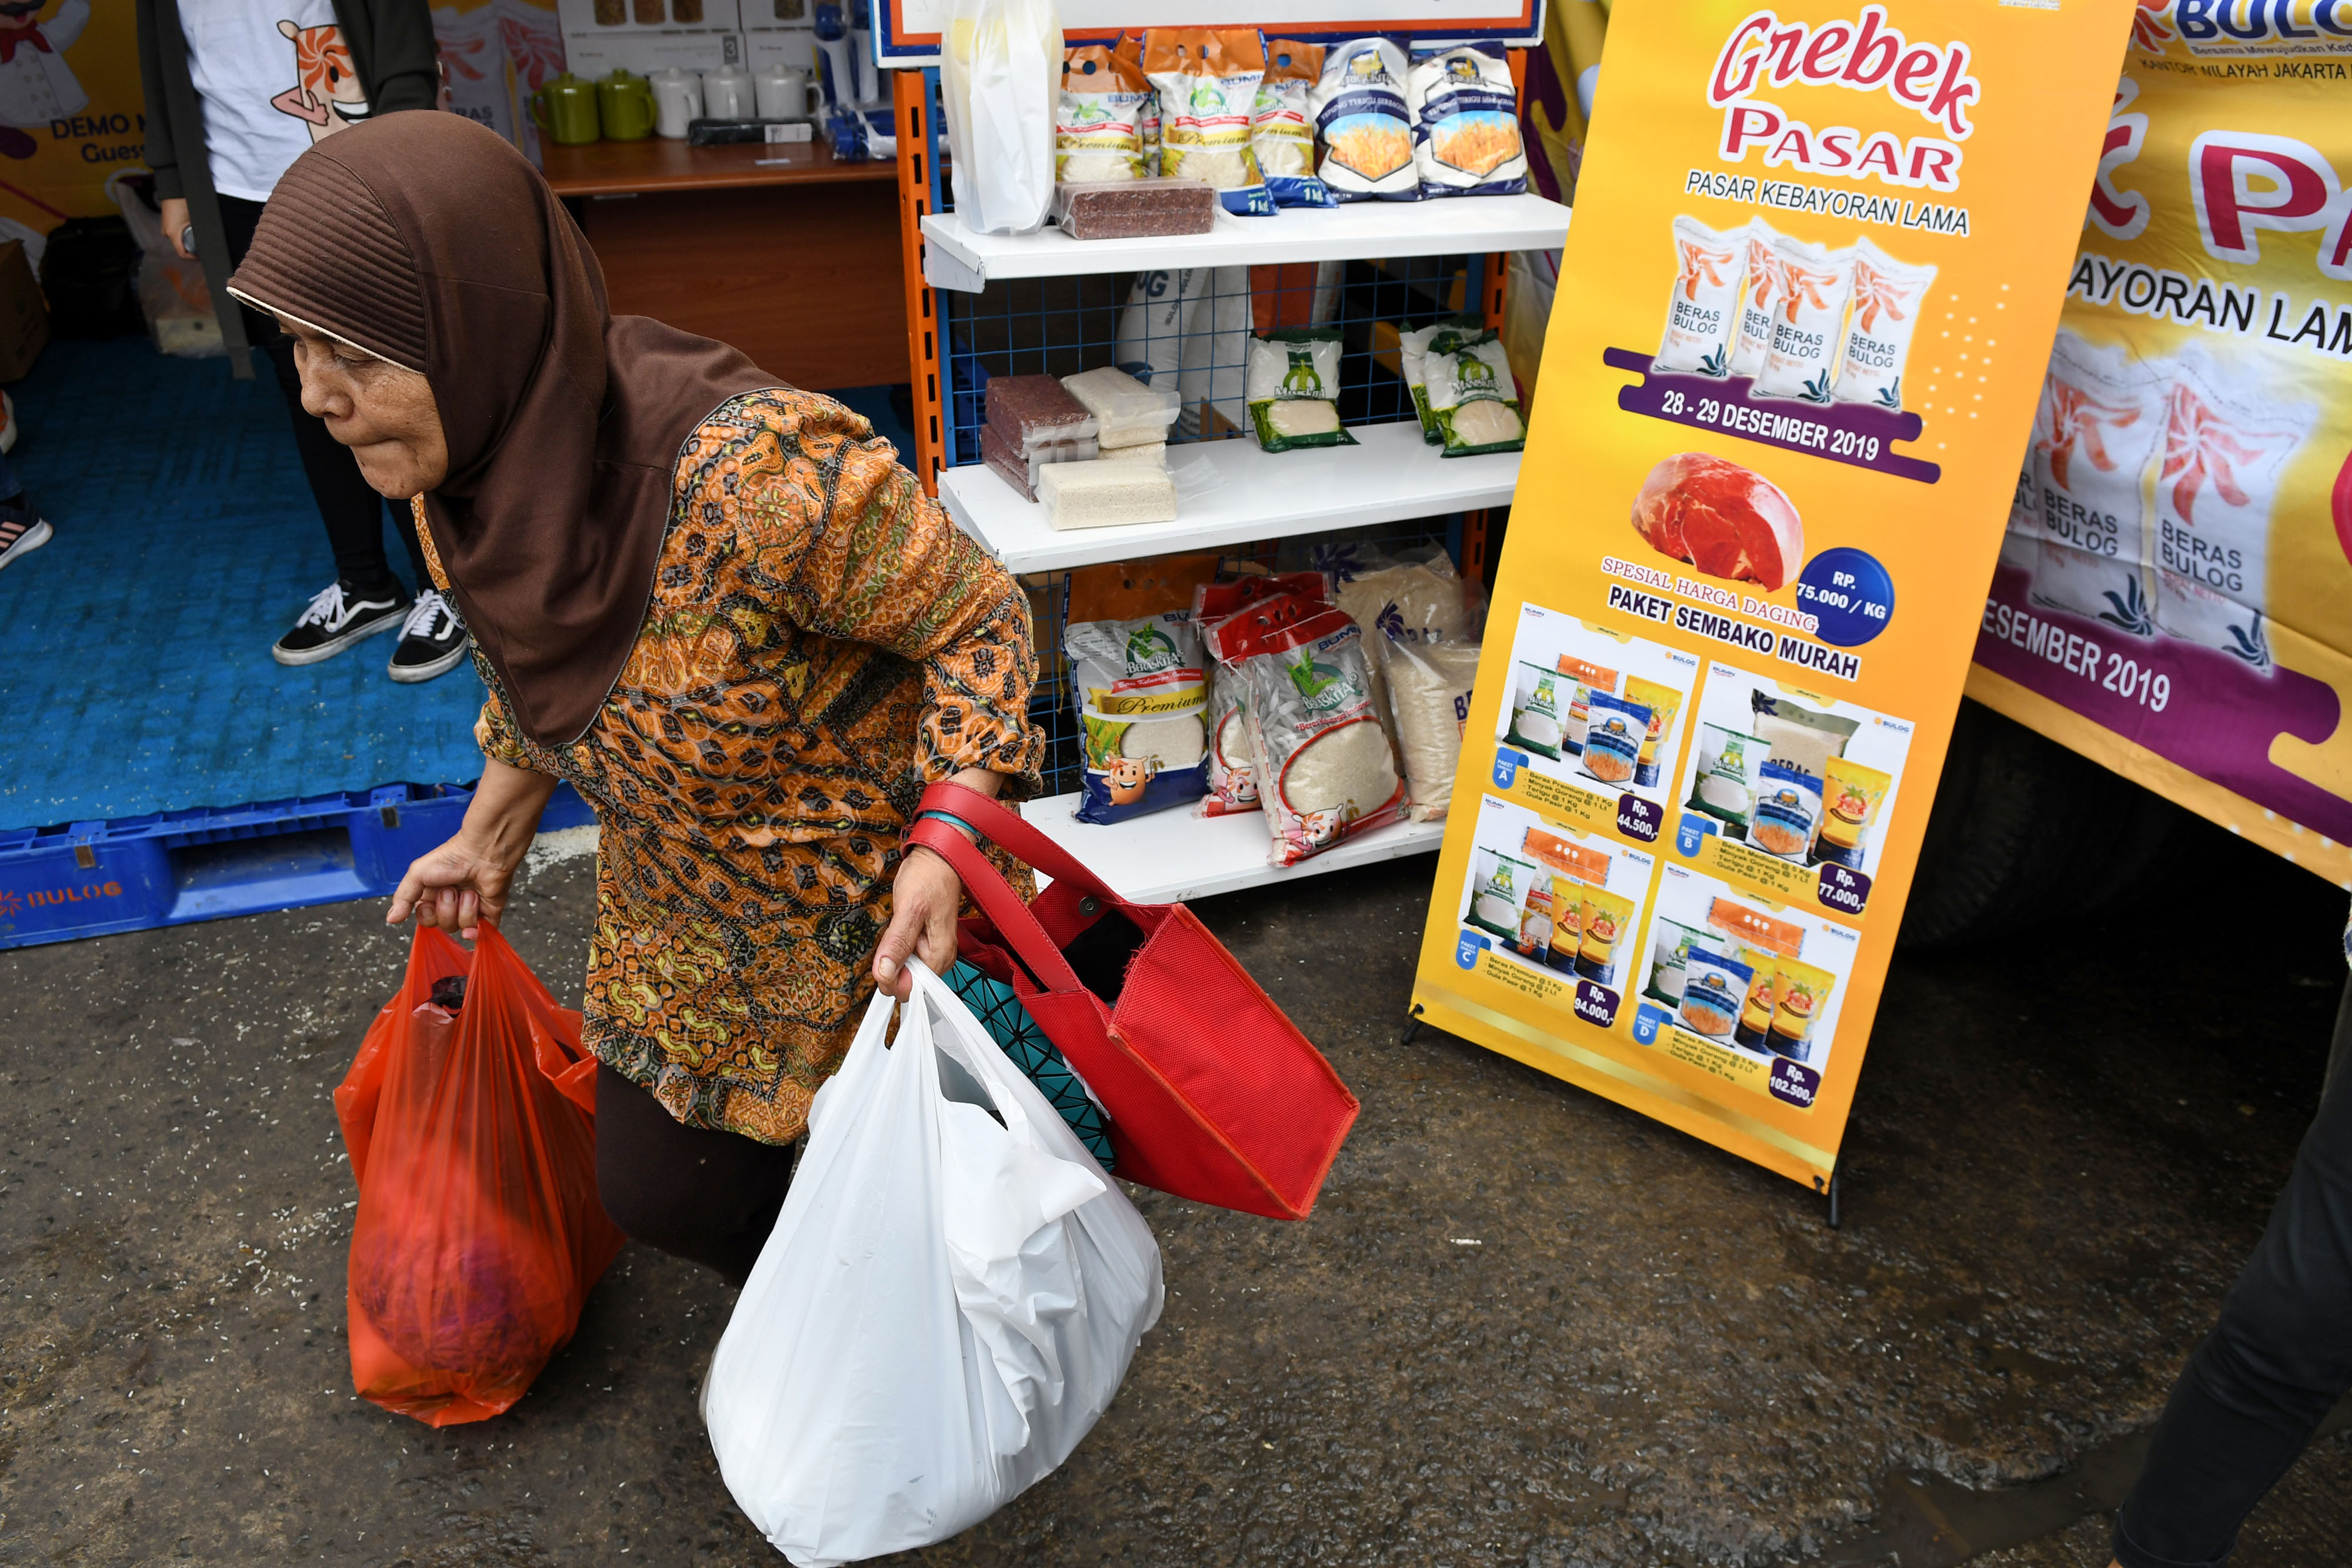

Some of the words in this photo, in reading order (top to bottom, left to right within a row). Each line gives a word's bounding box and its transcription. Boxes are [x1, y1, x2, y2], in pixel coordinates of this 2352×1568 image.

[2245, 44, 2326, 55] Mewujudkan
[1713, 11, 1973, 133] Grebek
[2274, 63, 2347, 79] JAKARTA
[1349, 96, 1377, 105] TERIGU
[51, 114, 129, 139] DEMO
[1178, 130, 1247, 146] Premium
[1060, 136, 1131, 150] Premium
[1727, 107, 1953, 183] PASAR
[1304, 187, 1311, 200] 1
[1688, 172, 1755, 201] PASAR
[1761, 182, 1897, 222] KEBAYORAN
[1904, 204, 1968, 233] LAMA
[1248, 200, 1255, 212] 1
[1677, 302, 1720, 322] BERAS
[2067, 257, 2254, 332] AYORAN
[2267, 298, 2352, 355] LAM
[1674, 314, 1718, 334] BULOG
[1744, 322, 1769, 339] BUL
[1746, 309, 1770, 328] BER
[1776, 324, 1823, 345] BERAS
[1852, 333, 1896, 355] BERAS
[1773, 338, 1820, 358] BULOG
[1849, 346, 1893, 367] BULOG
[1662, 390, 1686, 416] 28
[1696, 397, 1718, 424] 29
[1722, 403, 1829, 449] DESEMBER
[1832, 429, 1879, 462] 2019
[2044, 488, 2117, 534] BERAS
[2046, 509, 2117, 556] BULOG
[2162, 519, 2242, 570] BERAS
[2162, 541, 2243, 593] BULOG
[1832, 571, 1856, 590] RP.
[1603, 558, 1672, 589] SPESIAL
[1676, 578, 1738, 609] HARGA
[1743, 597, 1818, 632] DAGING
[1797, 583, 1849, 609] 75.000
[1864, 602, 1887, 620] KG
[1318, 626, 1362, 651] BUMN
[1608, 586, 1672, 621] PAKET
[1676, 606, 1774, 653] SEMBAKO
[1779, 637, 1859, 679] MURAH
[1673, 654, 1696, 666] BULOG
[1982, 602, 2102, 682] ESEMBER
[2102, 653, 2171, 713] 2019
[1117, 695, 1202, 714] Premium
[1883, 721, 1910, 733] BULOG
[1499, 771, 1508, 781] A
[1528, 778, 1553, 792] Minyak
[1555, 787, 1582, 803] Goreng
[1528, 784, 1551, 798] Terigu
[1567, 799, 1578, 808] Kg
[1529, 772, 1551, 784] Beras
[1552, 780, 1585, 796] Premium
[1602, 798, 1613, 807] Kg
[1526, 791, 1542, 801] Gula
[1544, 797, 1562, 808] Pasir
[1580, 810, 1590, 820] Kg
[1632, 800, 1649, 817] Rp.
[1617, 814, 1658, 840] 44.500,-
[1683, 837, 1693, 848] B
[1628, 852, 1651, 865] BULOG
[1719, 854, 1744, 869] Terigu
[1763, 871, 1775, 881] Kg
[1720, 848, 1748, 862] Minyak
[1750, 858, 1780, 875] Goreng
[1782, 870, 1791, 878] @
[1722, 841, 1746, 854] Beras
[1748, 850, 1780, 867] Medium
[1781, 862, 1790, 871] @
[1799, 868, 1811, 878] Kg
[1760, 877, 1769, 885] @
[1835, 868, 1855, 887] Rp.
[27, 881, 123, 908] BULOG
[1819, 882, 1866, 911] 77.000,-
[1462, 951, 1471, 962] C
[1486, 969, 1502, 981] Gula
[1502, 976, 1519, 987] Pasir
[1534, 989, 1543, 998] Kg
[1488, 962, 1509, 976] Minyak
[1511, 972, 1535, 988] Goreng
[1490, 956, 1508, 968] Beras
[1509, 964, 1538, 980] Premium
[1552, 983, 1562, 992] Kg
[1589, 985, 1606, 1002] Rp.
[1574, 998, 1613, 1024] 94.000,-
[1640, 1026, 1649, 1037] D
[1786, 1064, 1805, 1083] Rp.
[1770, 1076, 1815, 1105] 102.500,-
